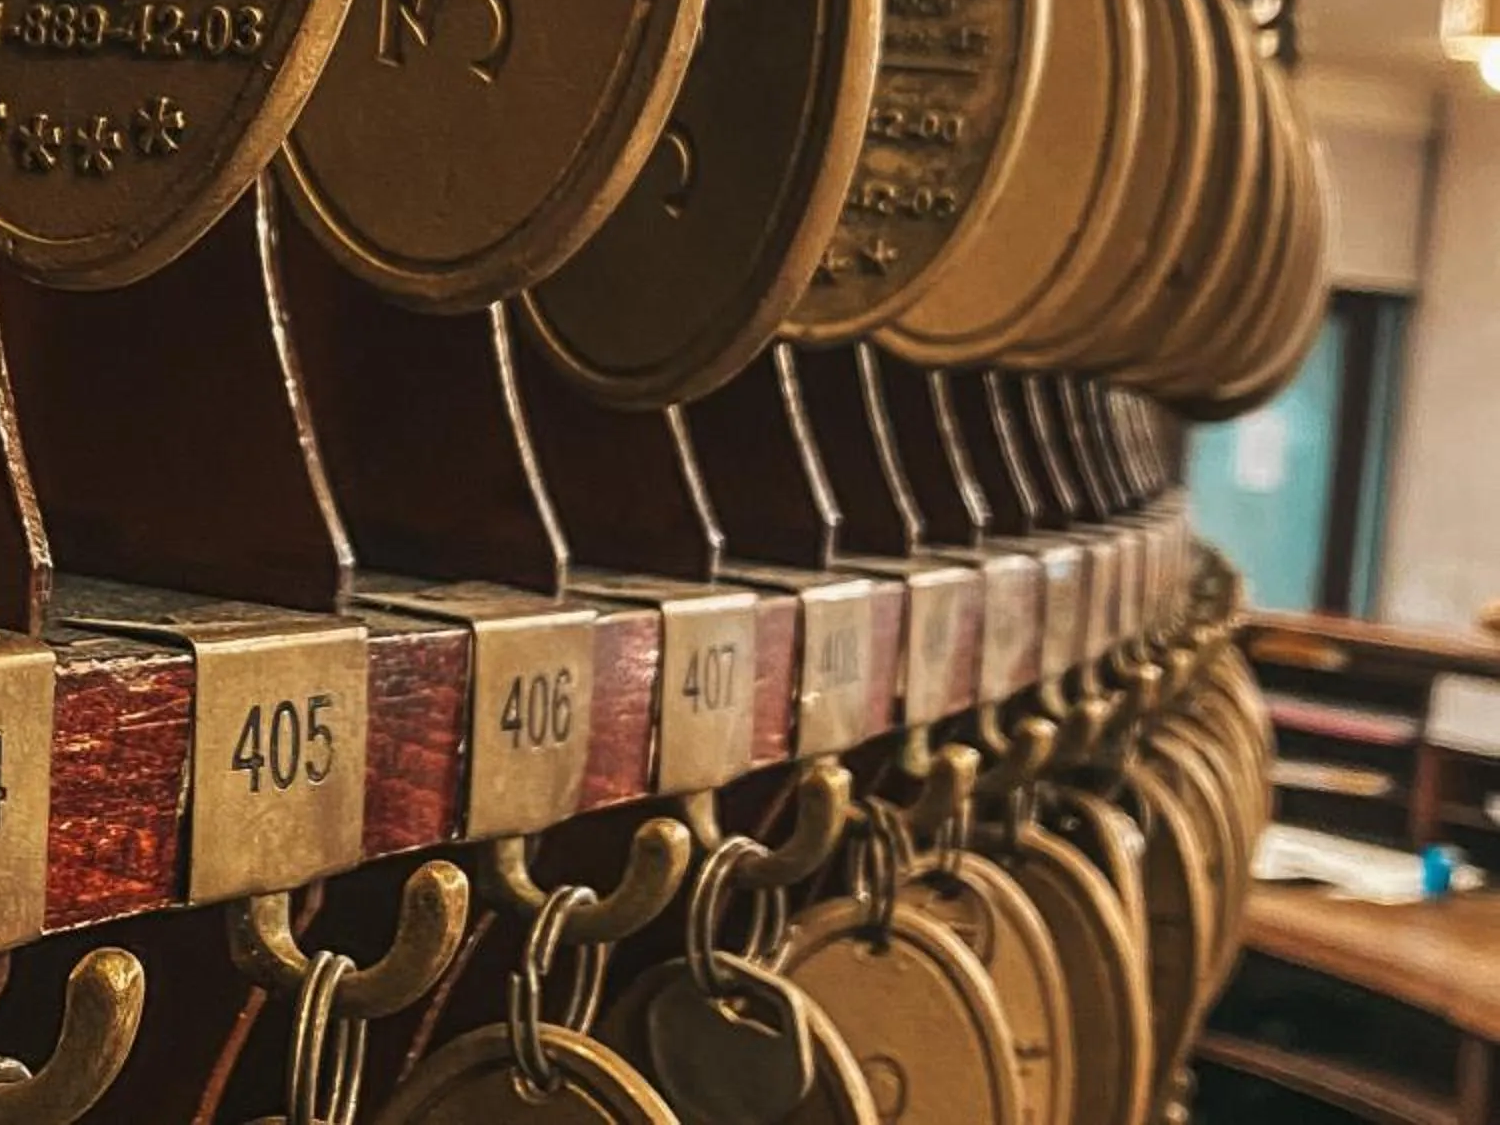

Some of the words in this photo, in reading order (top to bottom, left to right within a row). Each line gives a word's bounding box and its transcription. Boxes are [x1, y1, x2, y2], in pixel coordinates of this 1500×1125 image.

[500, 666, 574, 749] 406
[681, 642, 737, 714] 407
[230, 693, 335, 794] 405
